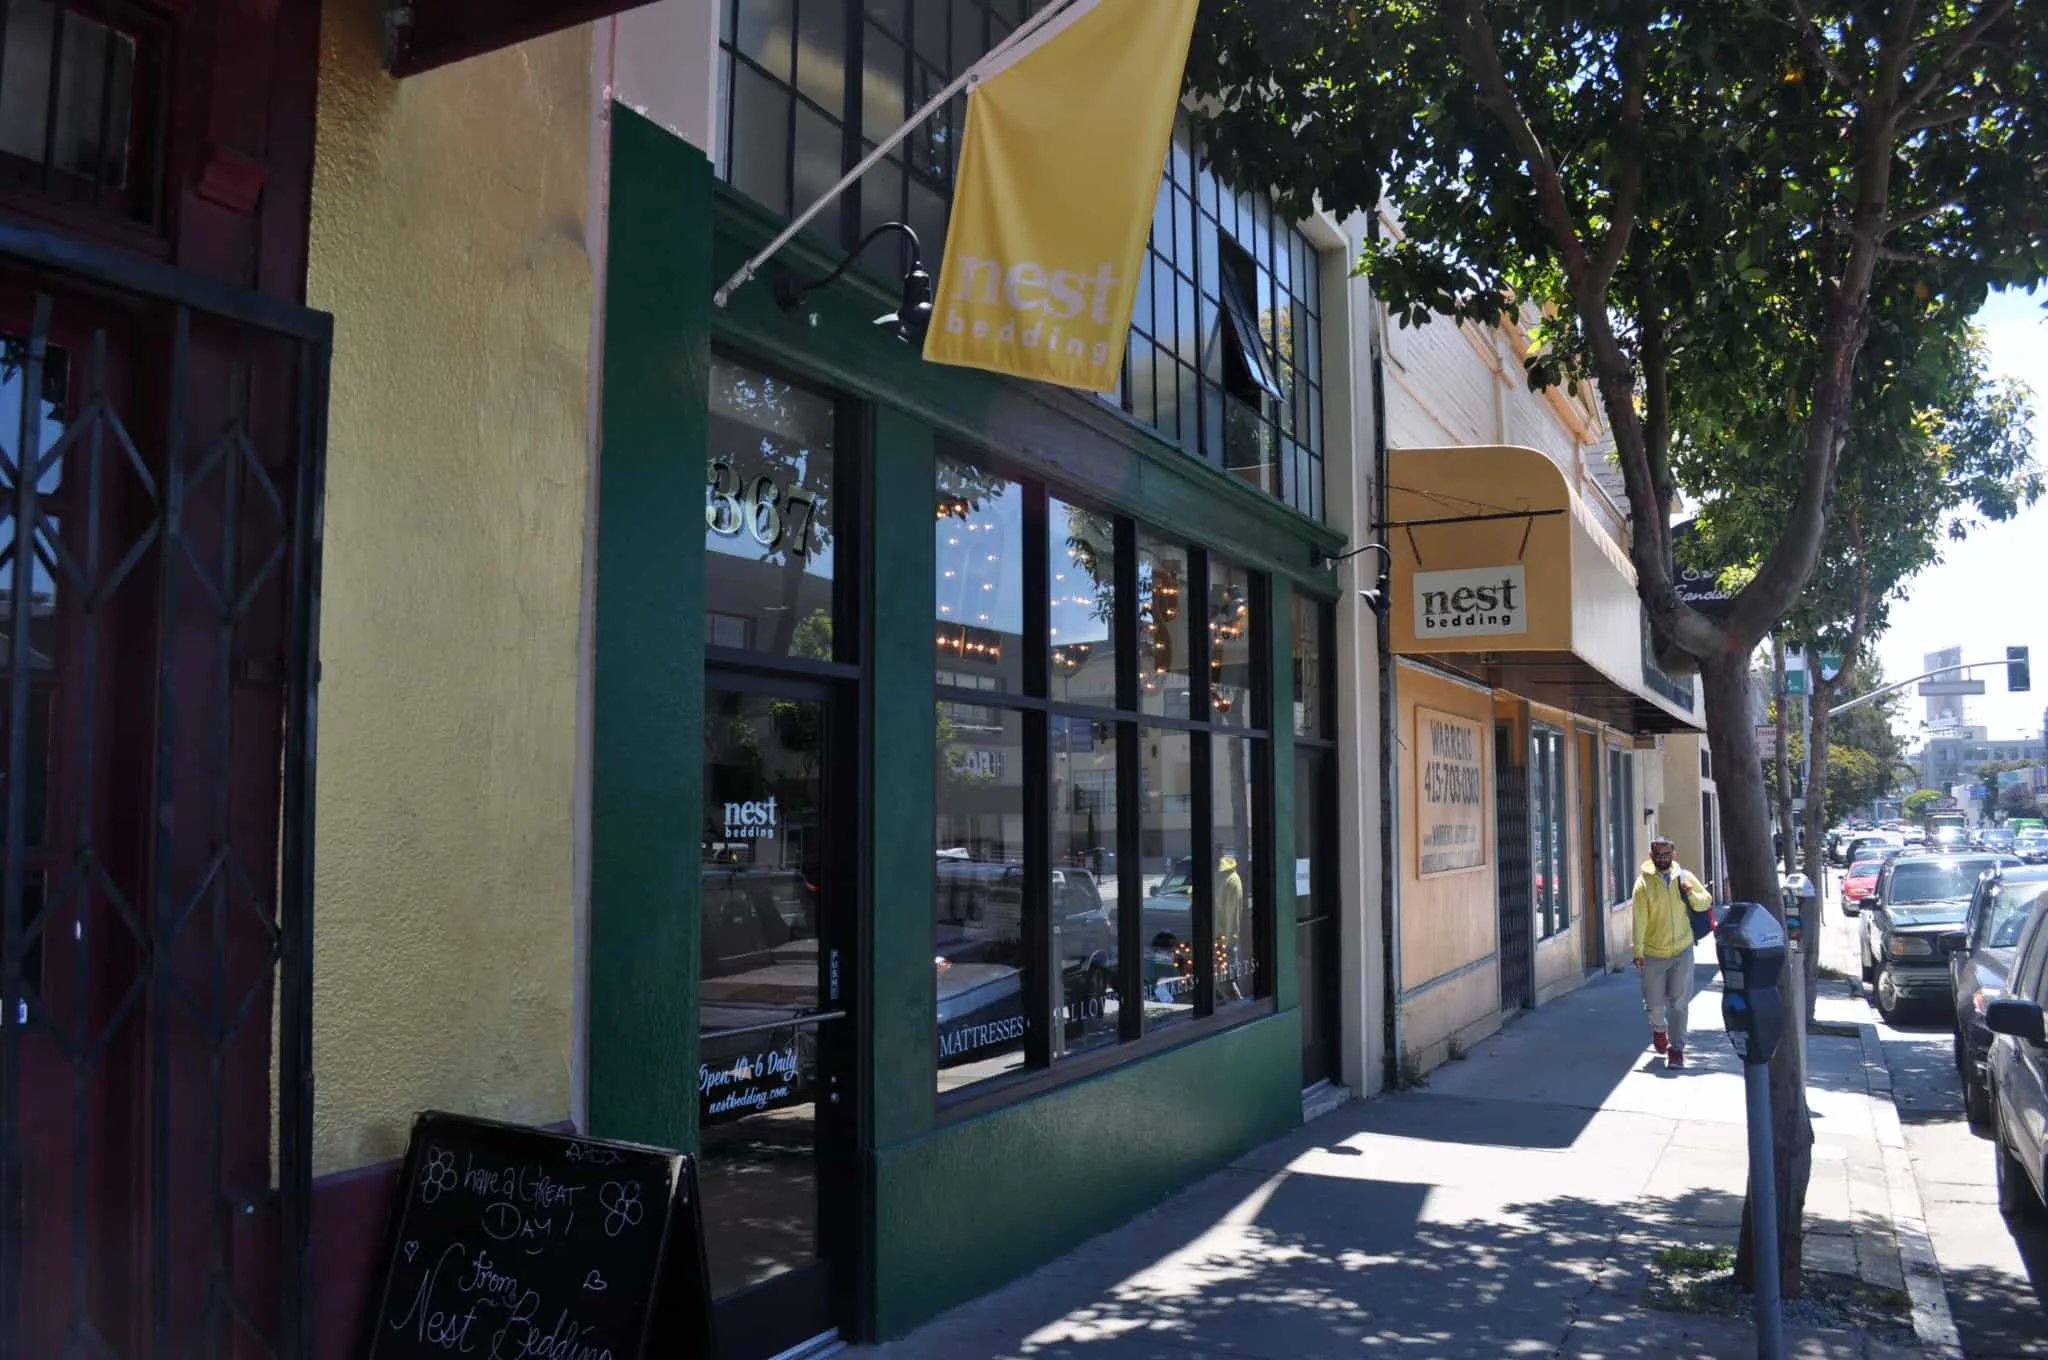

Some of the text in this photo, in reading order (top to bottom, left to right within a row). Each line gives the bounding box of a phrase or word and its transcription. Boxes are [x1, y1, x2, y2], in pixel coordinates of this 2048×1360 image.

[952, 255, 1120, 326] nest
[946, 307, 1109, 367] bedding
[705, 462, 817, 556] 367
[1421, 576, 1518, 615] nest
[1426, 613, 1512, 629] bedding
[724, 793, 778, 826] nest
[725, 826, 774, 839] bedding
[939, 1015, 1025, 1058] MATTRESSES
[699, 1063, 731, 1096] Open
[767, 1047, 799, 1082] Daily
[708, 1085, 790, 1115] nestbedding.com
[464, 1152, 498, 1195] have
[502, 1167, 516, 1196] a
[390, 1243, 478, 1353] Nest
